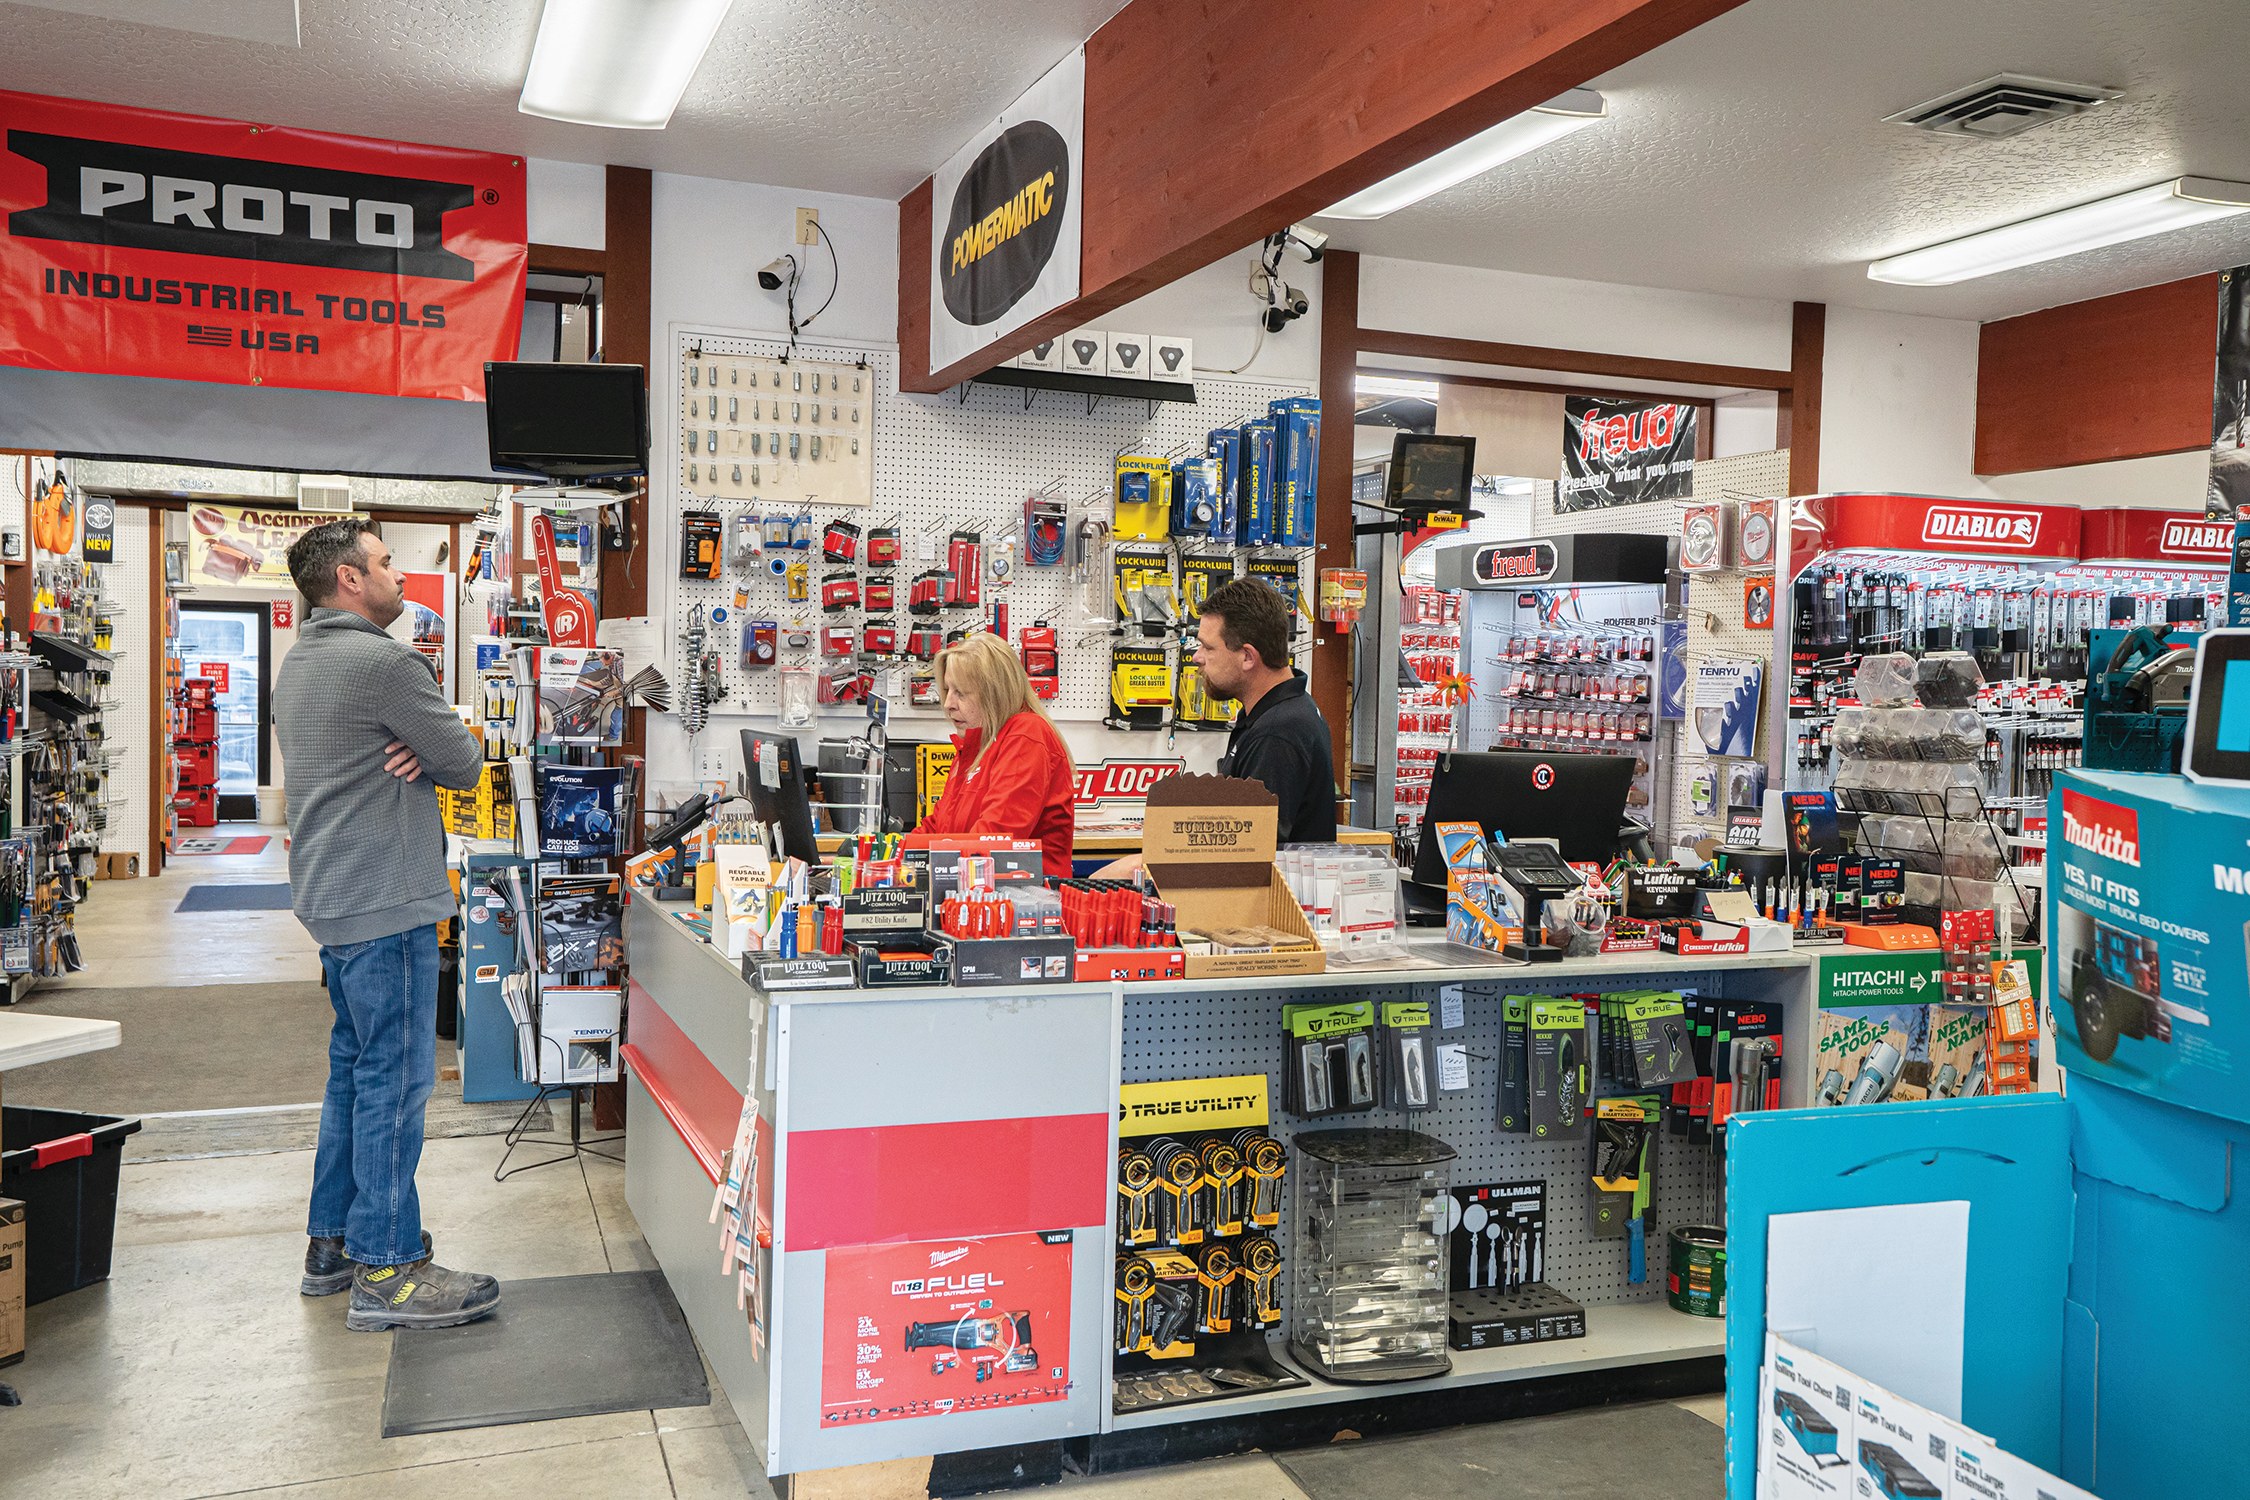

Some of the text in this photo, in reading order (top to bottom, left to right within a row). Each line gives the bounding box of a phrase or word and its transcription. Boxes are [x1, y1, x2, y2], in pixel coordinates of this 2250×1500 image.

[80, 166, 414, 249] PROTO
[951, 171, 1054, 277] POWERMATIC
[45, 268, 446, 328] INDUSTRIAL TOOLS
[241, 329, 319, 355] USA
[1580, 404, 1678, 461] freud
[1564, 472, 1609, 491] Precisely
[1614, 467, 1641, 483] what
[1646, 464, 1666, 478] you
[1931, 513, 2010, 539] DIABLO
[86, 532, 111, 540] WHAT'S
[86, 540, 111, 551] NEW
[1492, 549, 1537, 577] freud
[2135, 571, 2186, 580] EXTRACTION
[2187, 573, 2210, 581] DRILL
[1604, 618, 1636, 626] ROUTER
[550, 657, 578, 666] SawStop
[1793, 653, 1819, 661] SAVE
[1699, 667, 1741, 676] TENRYU
[1792, 795, 1825, 805] NEBO
[1173, 821, 1253, 834] HUMBOLDT
[1188, 834, 1237, 846] HANDS
[2062, 810, 2141, 868] Makita
[728, 869, 766, 877] REUSABLE
[1817, 863, 1837, 873] NEB
[1644, 874, 1686, 886] Lufkin
[1870, 870, 1898, 879] NEBO
[1646, 886, 1679, 894] KEYCHAIN
[2064, 861, 2140, 907] YES, IT FITS
[859, 891, 909, 906] LUTZ TOOL
[1655, 895, 1668, 906] 6'
[874, 915, 892, 925] Utility
[892, 915, 908, 924] Knife
[2086, 893, 2108, 912] MOST
[2109, 901, 2138, 923] TRUCK
[2162, 919, 2211, 945] COVERS
[1712, 942, 1745, 952] Lufkin
[784, 960, 829, 975] LUTZ TOOL
[886, 961, 933, 975] LUTZ TOOL
[961, 965, 976, 973] CPM
[1833, 970, 1905, 987] HITACHI
[1883, 987, 1904, 995] TOOLS
[1647, 1005, 1672, 1016] TRUE
[1325, 1016, 1359, 1028] TRUE
[1403, 1015, 1426, 1023] TRUE
[1550, 1015, 1580, 1023] TRUE
[1737, 1013, 1767, 1025] NEBO
[573, 1028, 613, 1036] TENRYU
[1937, 1011, 1974, 1043] NEW
[1820, 1016, 1869, 1053] SAME
[1839, 1019, 1890, 1058] TOOLS
[1947, 1020, 1987, 1052] NAM
[1132, 1095, 1257, 1118] TRUE UTILITY
[1491, 1186, 1541, 1198] ULLMAN
[1047, 1234, 1070, 1243] NEW
[929, 1246, 969, 1265] Milwaukee
[894, 1272, 1004, 1293] M18 FUEL
[910, 1292, 934, 1300] DRIVEN
[857, 1319, 873, 1328] 2X
[856, 1345, 882, 1356] 30%
[1775, 1361, 1833, 1400] Rolling Tool Chest
[1858, 1404, 1914, 1444] Large Tool Box
[1955, 1455, 2005, 1490] Extra Large
[1954, 1469, 1998, 1500] Extension
